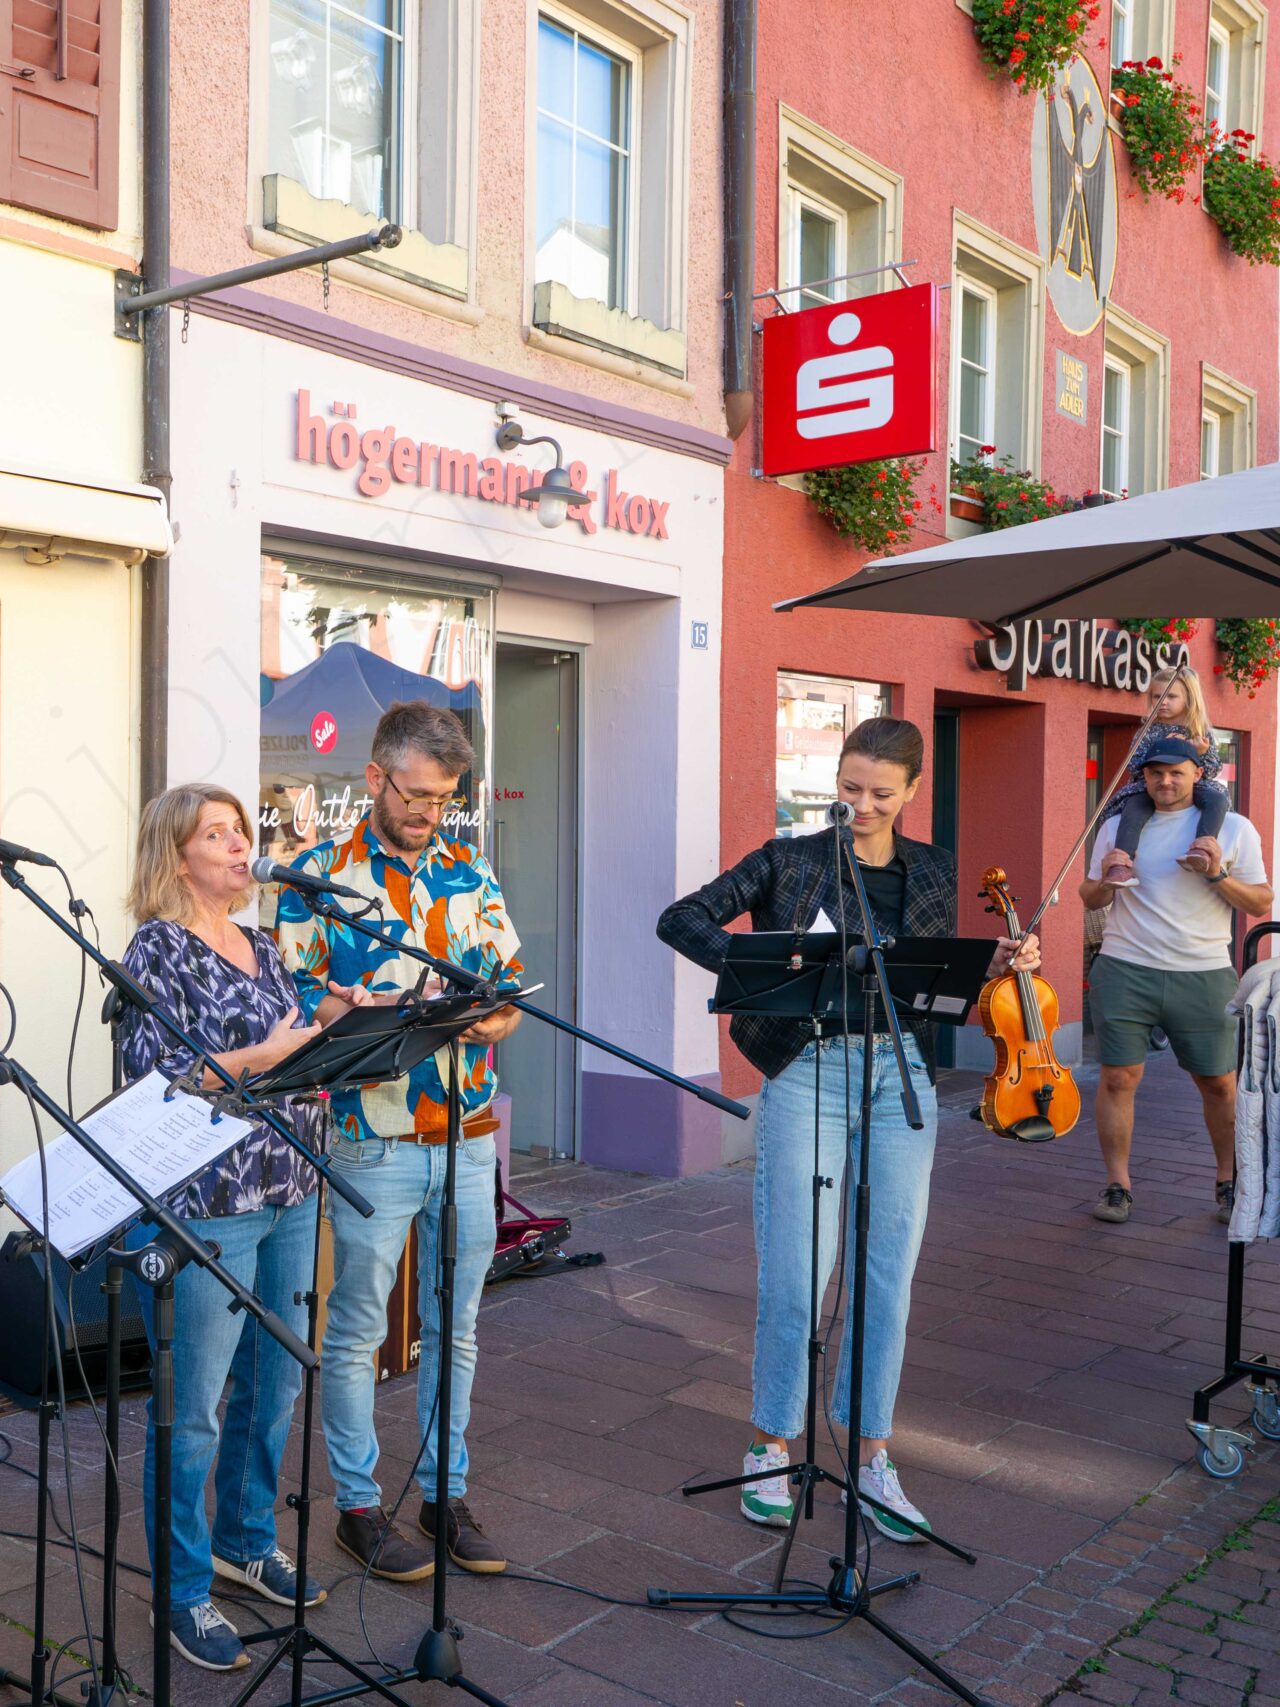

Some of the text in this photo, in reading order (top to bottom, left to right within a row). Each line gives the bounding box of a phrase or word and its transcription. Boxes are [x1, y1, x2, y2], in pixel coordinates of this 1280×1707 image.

[1059, 390, 1084, 418] ADLER
[567, 460, 597, 534] &
[607, 468, 670, 540] kox
[694, 626, 706, 645] 15
[314, 720, 336, 748] Sale
[504, 787, 524, 800] kox
[259, 801, 281, 827] ie
[293, 784, 374, 837] Outlet
[149, 1252, 157, 1281] K&M
